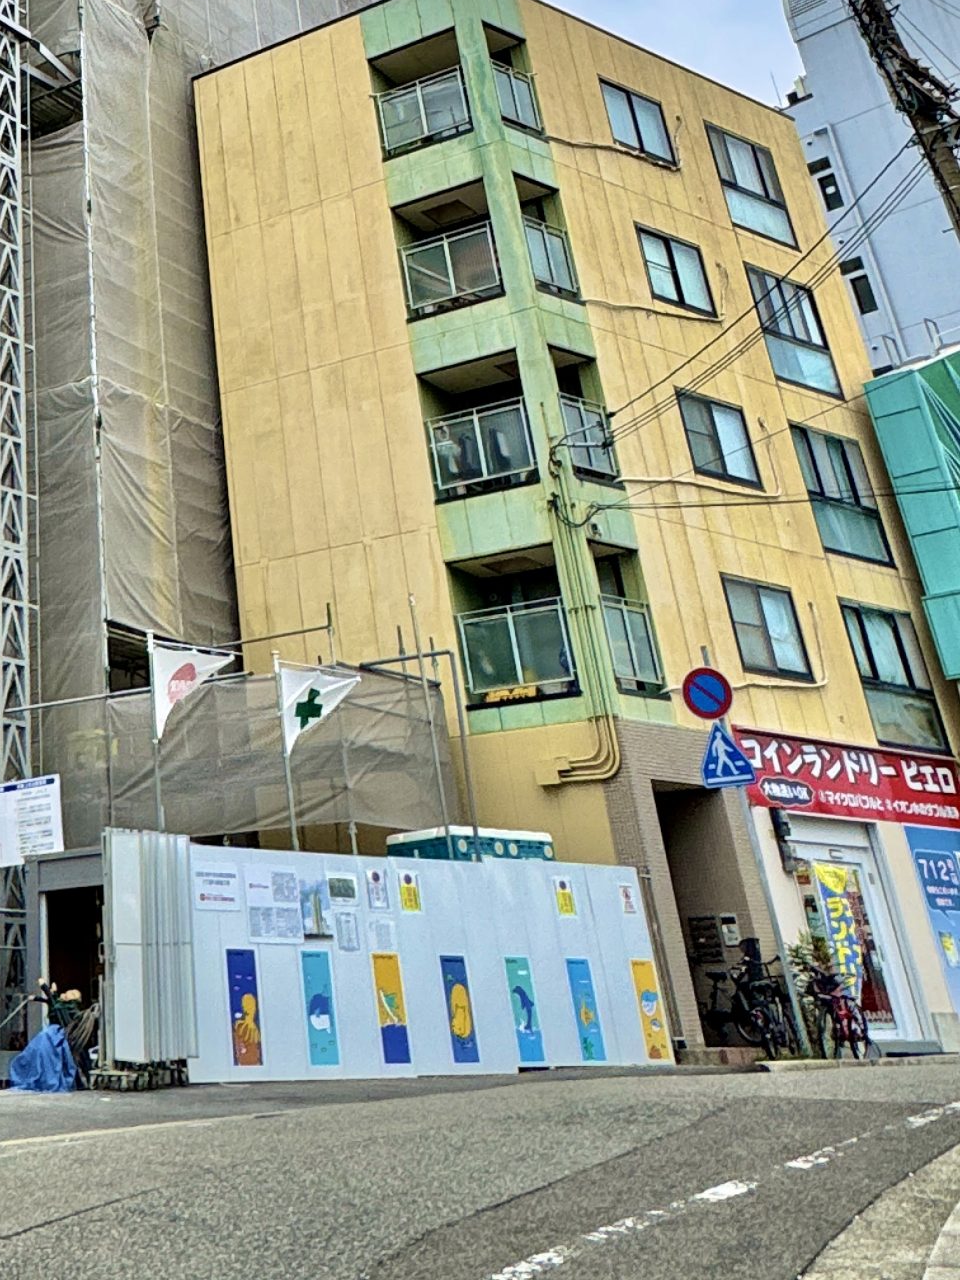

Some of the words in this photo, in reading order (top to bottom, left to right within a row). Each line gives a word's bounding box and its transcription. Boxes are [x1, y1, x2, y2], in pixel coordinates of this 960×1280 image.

[740, 739, 897, 785] コインランドリー
[918, 858, 950, 881] 712
